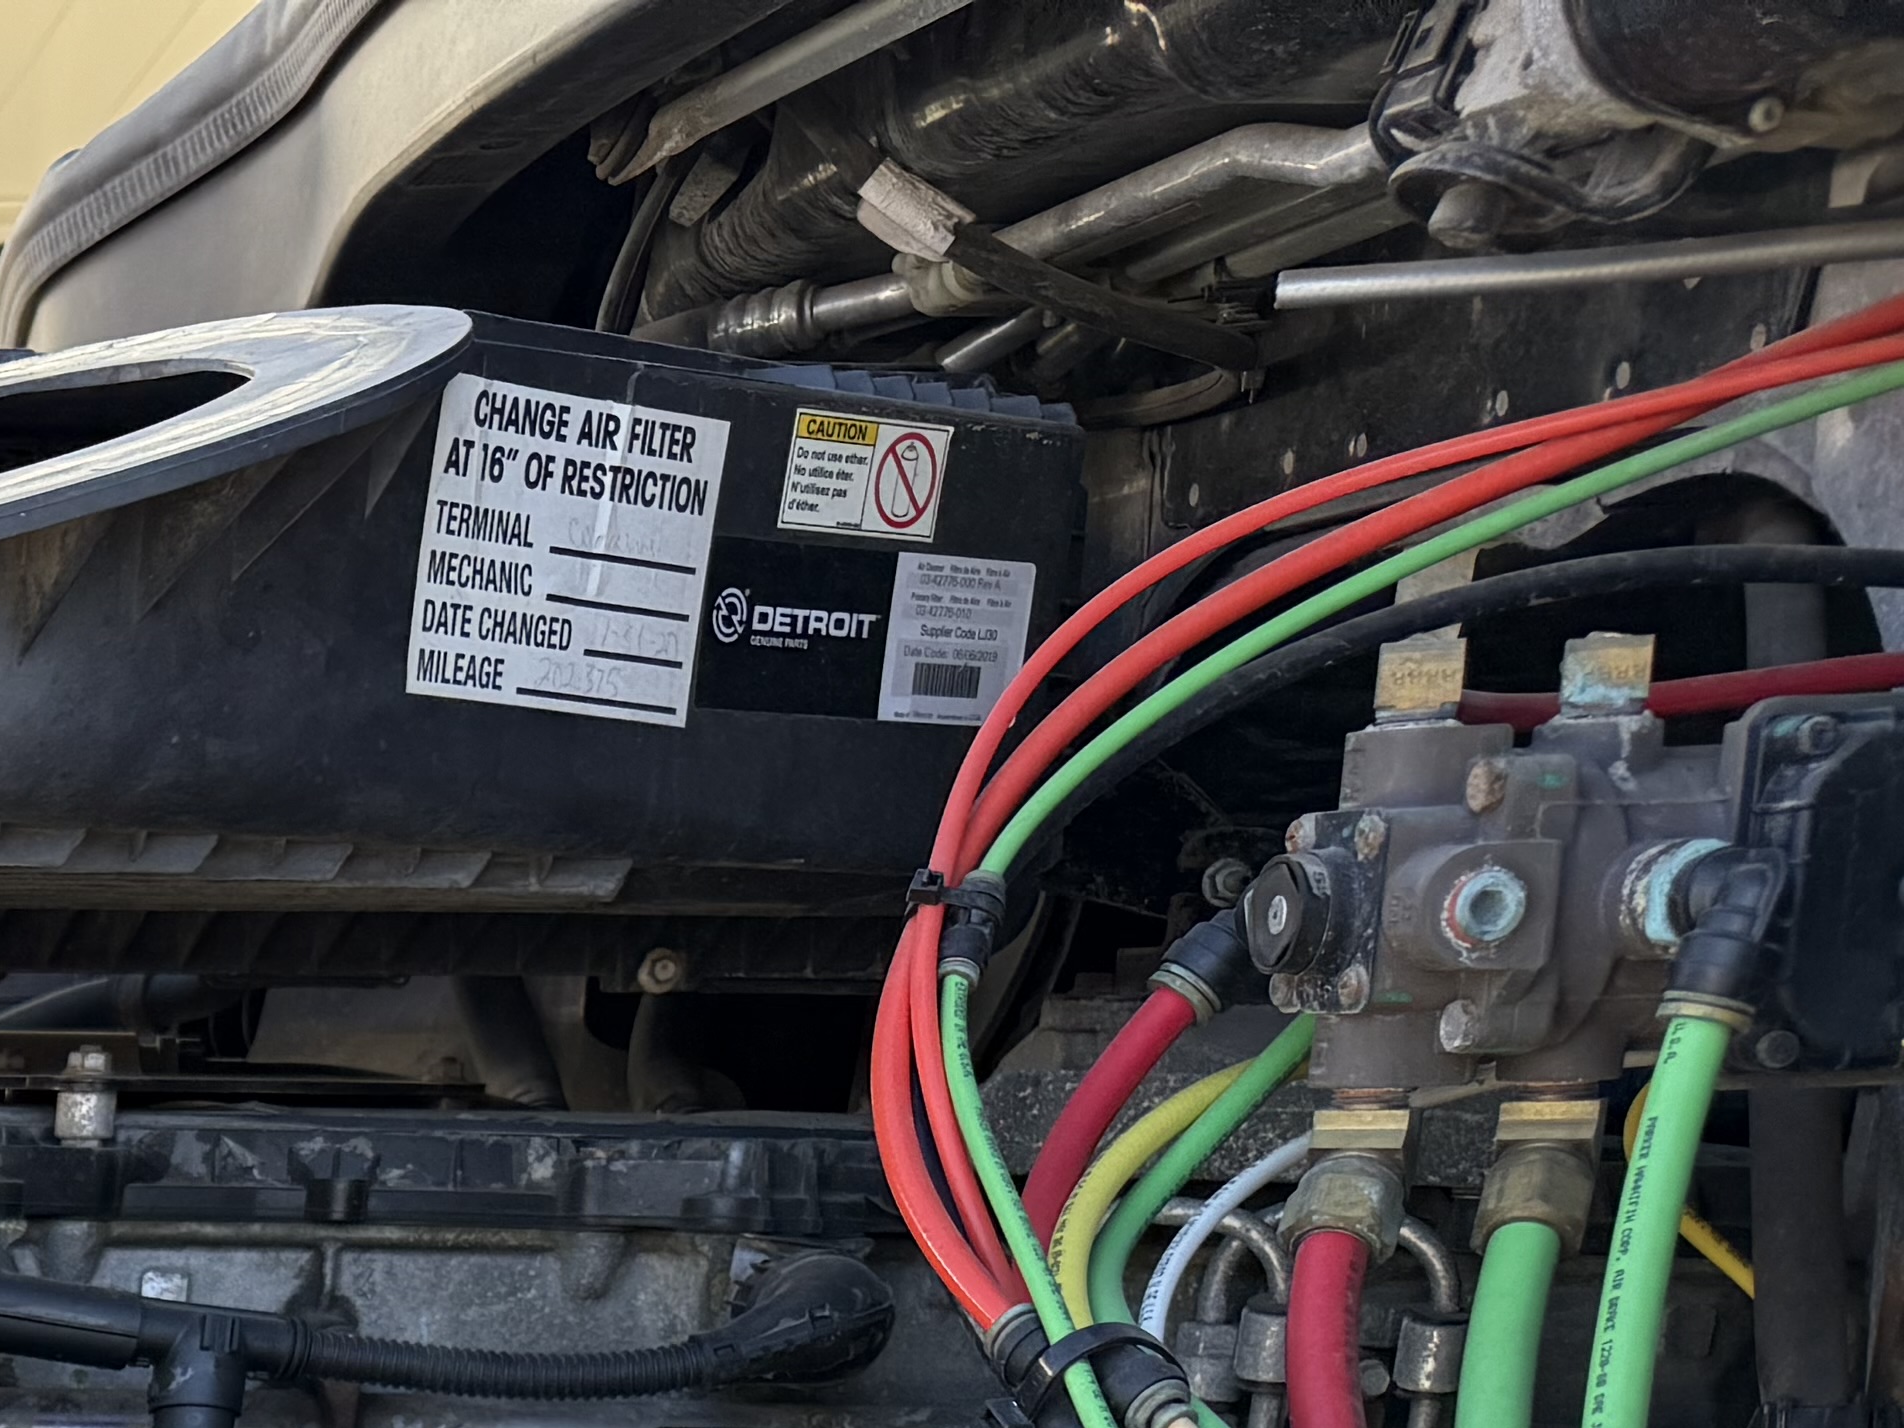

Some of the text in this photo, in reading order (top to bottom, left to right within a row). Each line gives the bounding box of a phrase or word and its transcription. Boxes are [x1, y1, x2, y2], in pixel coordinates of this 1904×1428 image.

[474, 390, 697, 463] CHANGE AIR FILTER
[807, 419, 867, 441] CAUTION
[794, 464, 806, 475] No
[797, 447, 868, 465] Do not use ether.
[444, 437, 475, 477] AT
[524, 452, 556, 491] OF
[560, 458, 708, 516] RESTRICTION
[831, 488, 847, 499] pas
[436, 500, 533, 548] TERMINAL
[426, 550, 532, 596] MECHANIC
[422, 600, 572, 651] DATE CHANGED
[752, 605, 876, 638] DETROIT
[920, 624, 953, 639] Supplier
[955, 627, 976, 640] Code
[750, 635, 783, 647] GENUINE
[904, 645, 923, 657] Date
[417, 648, 505, 690] MILEAGE
